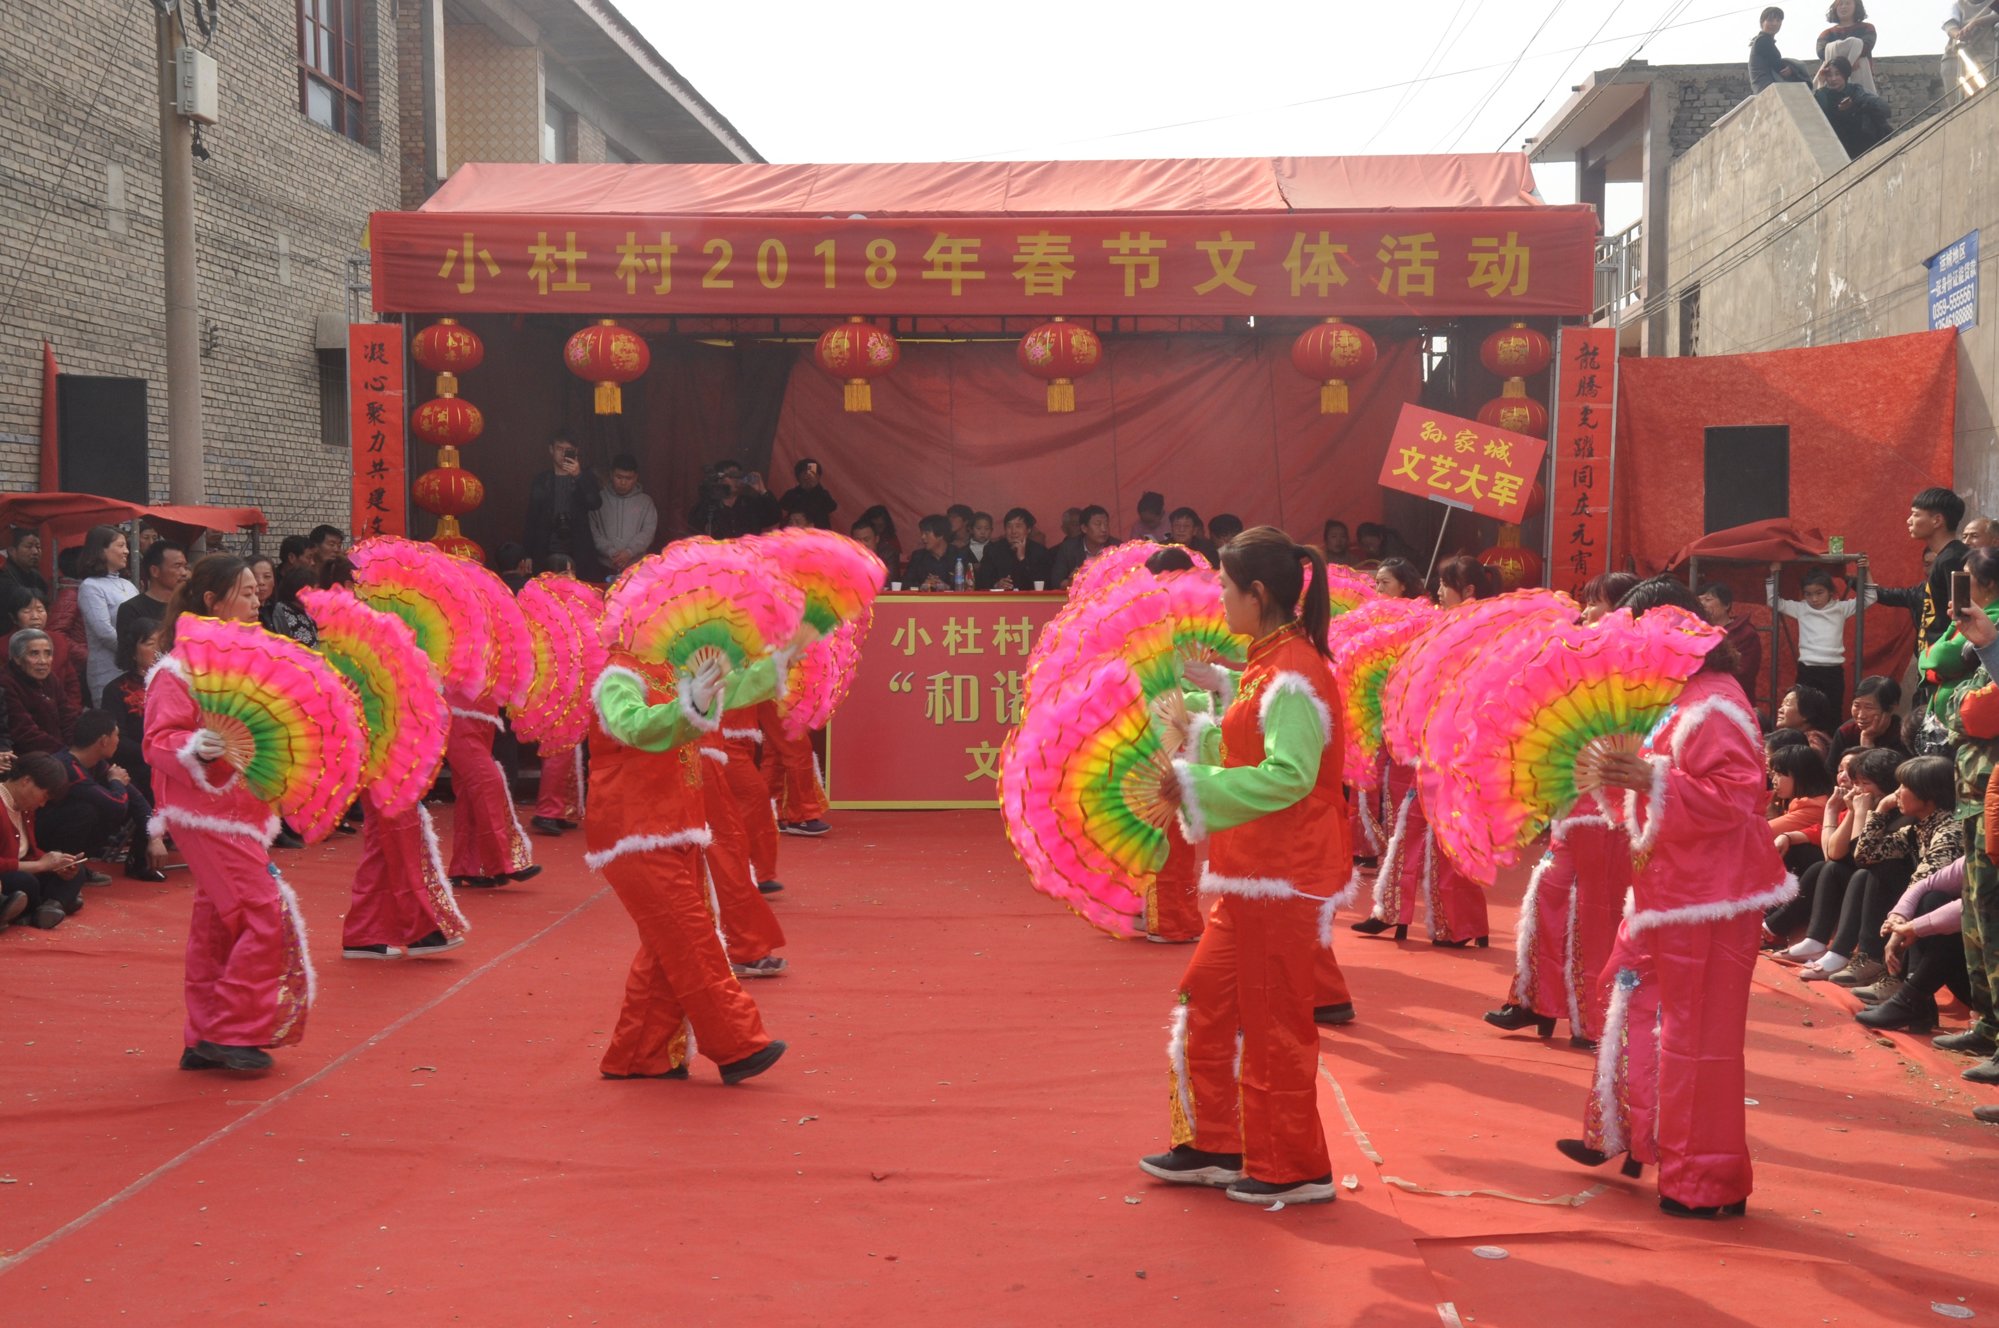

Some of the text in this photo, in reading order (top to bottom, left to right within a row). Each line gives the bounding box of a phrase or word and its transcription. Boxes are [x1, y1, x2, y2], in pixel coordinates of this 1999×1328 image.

[440, 230, 1531, 299] 小杜村2018年春节文体活动
[1420, 420, 1513, 469] 孙家城
[1392, 446, 1524, 508] 文艺大军
[890, 616, 1034, 656] 小杜村
